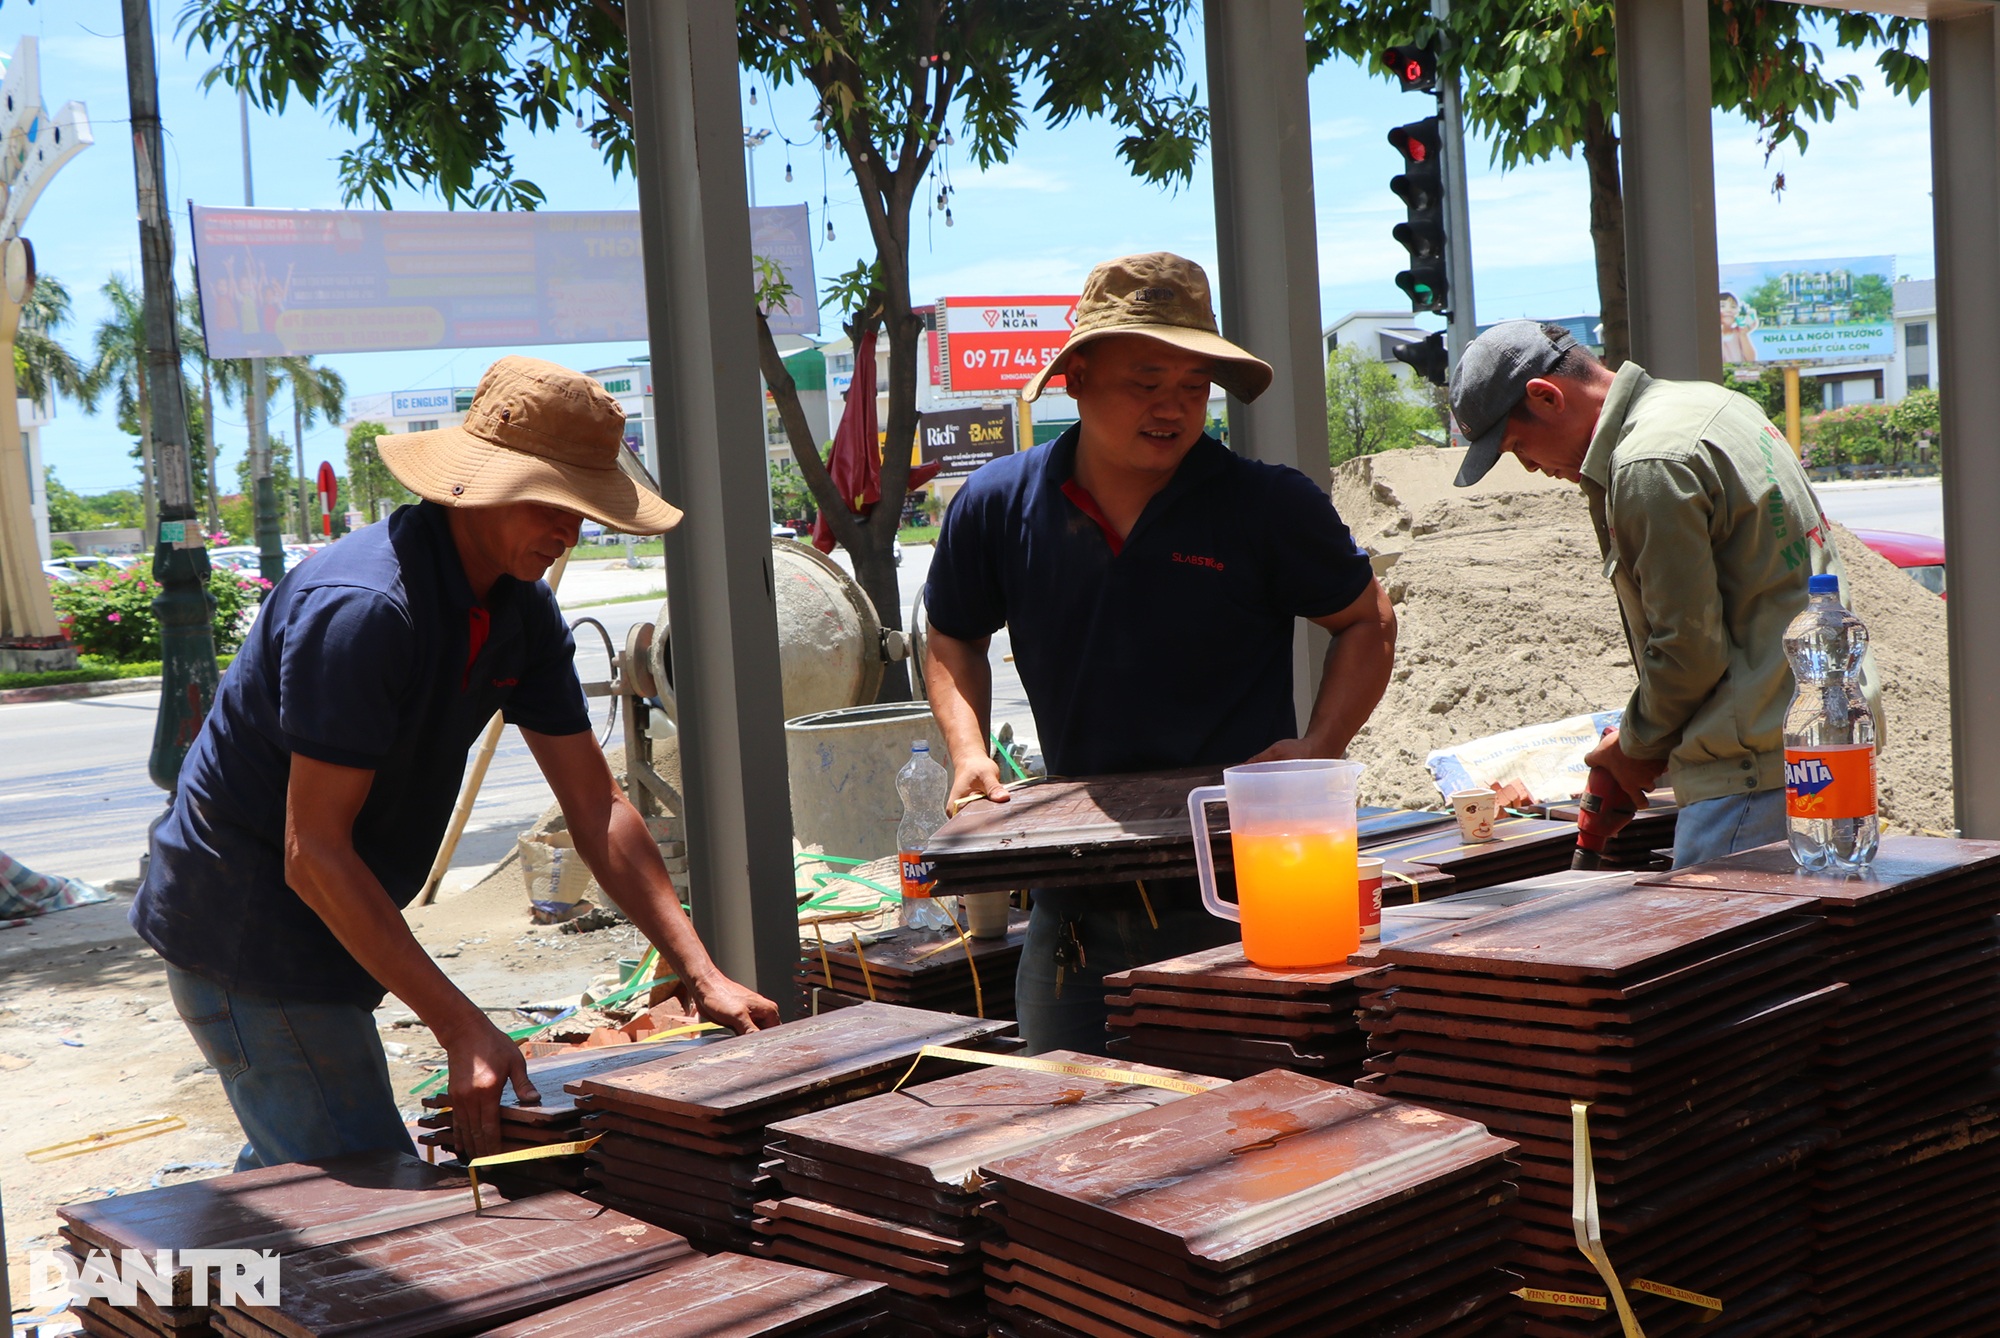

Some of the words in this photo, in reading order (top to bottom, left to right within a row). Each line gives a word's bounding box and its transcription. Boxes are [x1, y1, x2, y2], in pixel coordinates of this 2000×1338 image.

[1002, 309, 1025, 318] KIM
[1003, 319, 1038, 328] NGAN
[1763, 331, 1786, 343] NHÀ
[1777, 347, 1795, 355] VUI
[1849, 343, 1870, 351] CON
[963, 349, 987, 368] 09
[990, 349, 1010, 368] 77
[1014, 348, 1037, 367] 44
[397, 399, 409, 409] BC
[411, 396, 448, 408] ENGLISH
[927, 424, 956, 446] Rich
[968, 423, 1004, 442] BANK
[1062, 1065, 1092, 1077] TRUNG
[1093, 1067, 1107, 1078] ĐÔ
[1181, 1083, 1206, 1094] TRUN
[1640, 1281, 1651, 1291] ĐÔ
[1652, 1284, 1676, 1299] TRUNG
[1552, 1293, 1567, 1303] ĐÔ
[1569, 1295, 1601, 1306] TRUNG
